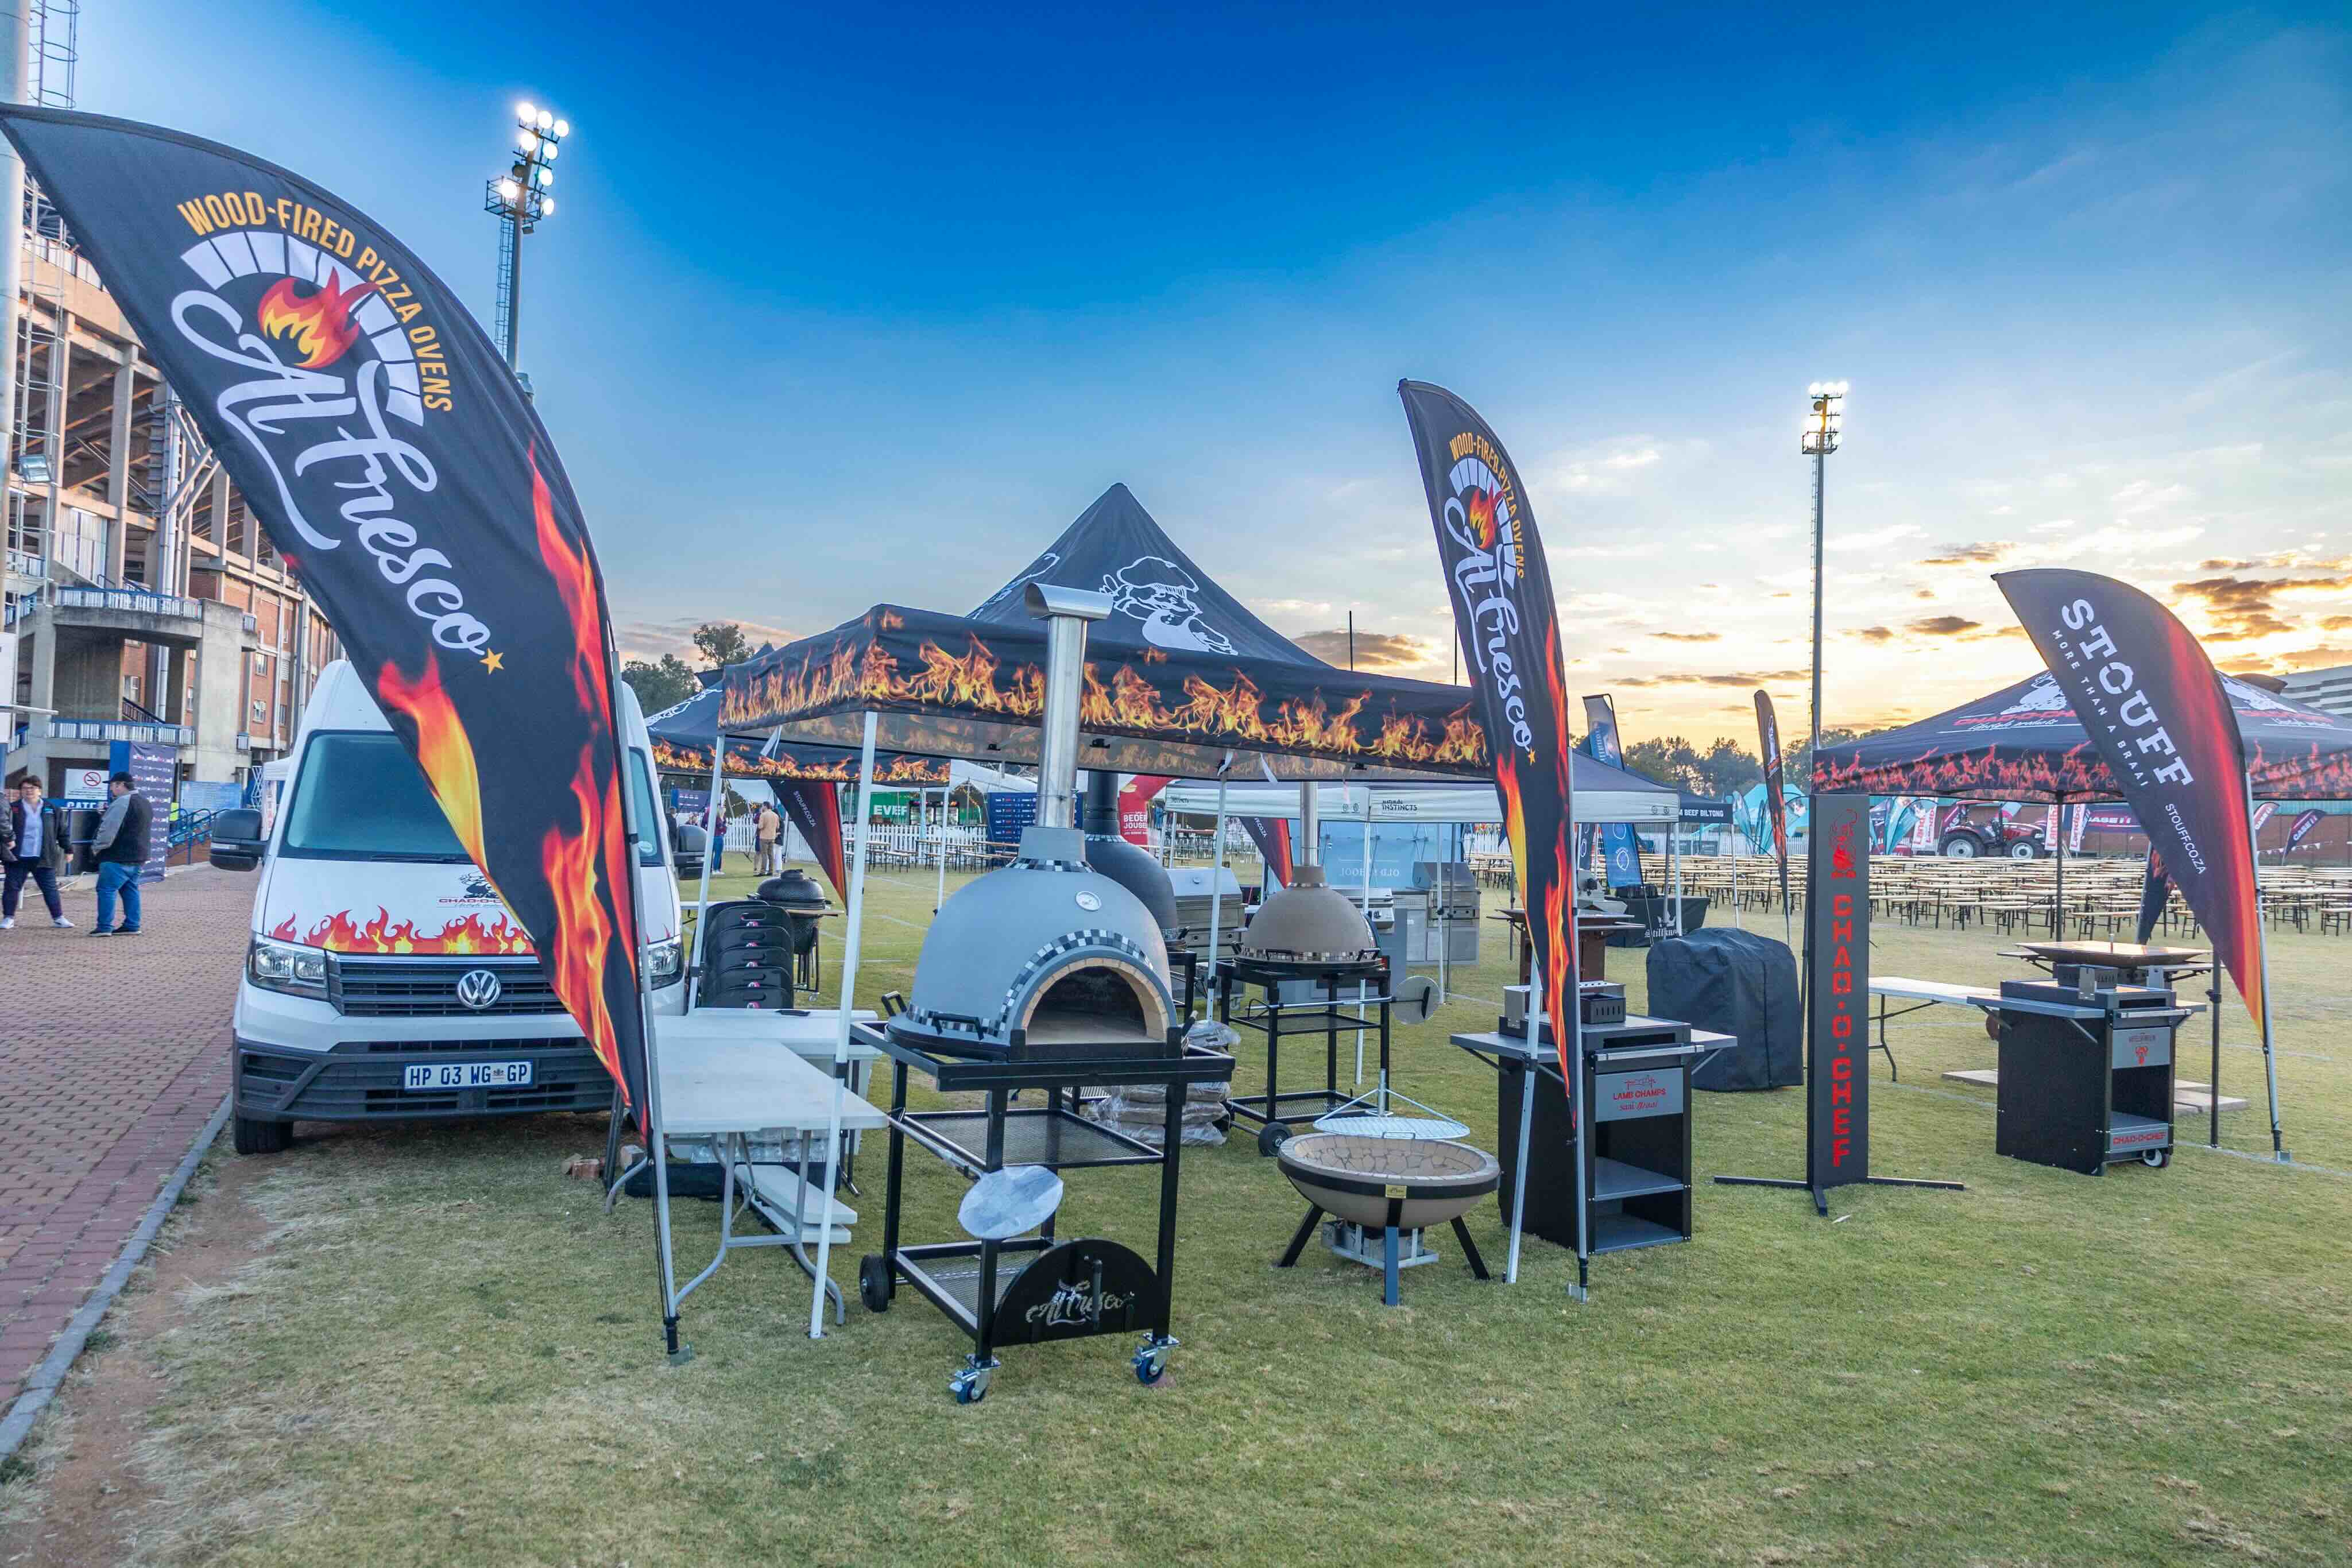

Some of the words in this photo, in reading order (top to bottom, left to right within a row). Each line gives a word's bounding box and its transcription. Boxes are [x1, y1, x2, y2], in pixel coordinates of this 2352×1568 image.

[177, 191, 356, 258] WOOD-FIRED
[355, 246, 423, 324] PIZZA
[409, 325, 452, 413] OVENS
[1449, 432, 1499, 474] WOOD-FIRED
[1498, 467, 1518, 514] PIZZA
[1512, 519, 1525, 580] OVENS
[2052, 630, 2080, 669] MORE
[2080, 676, 2108, 717] THAN
[2107, 725, 2117, 733] A
[2117, 740, 2149, 786] BRAAI
[2061, 599, 2194, 785] STOUFF
[2165, 803, 2206, 874] STOUFF.CO.ZA
[410, 1067, 431, 1086] HP
[471, 1066, 491, 1084] WG
[507, 1064, 527, 1082] GP
[1635, 1088, 1666, 1098] CHAMPS
